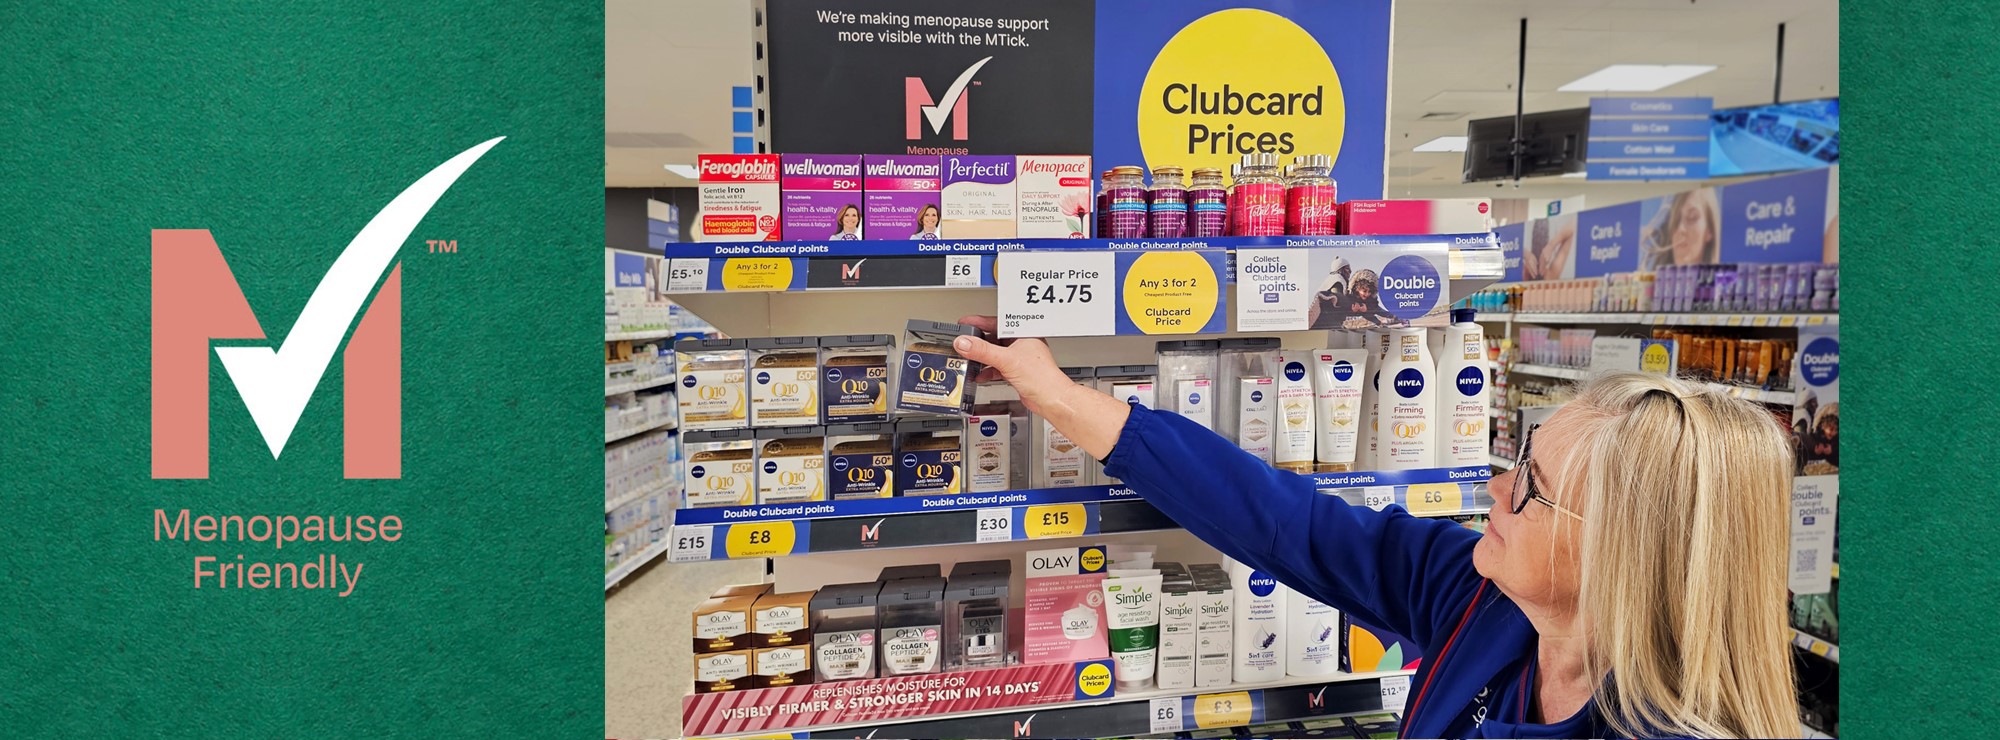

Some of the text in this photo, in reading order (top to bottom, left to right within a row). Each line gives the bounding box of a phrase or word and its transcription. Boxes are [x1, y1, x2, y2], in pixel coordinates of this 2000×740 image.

[816, 10, 1050, 32] We're making menopause support
[838, 28, 1030, 47] more visible with the MTick.
[1162, 83, 1323, 116] Clubcard
[1631, 102, 1673, 111] Cosmetics
[1651, 124, 1669, 132] Care
[1188, 123, 1295, 154] Prices
[907, 145, 969, 156] Menopause
[701, 159, 776, 178] Feroglobin
[784, 159, 859, 176] wellwoman
[866, 159, 939, 176] wellwoman
[948, 158, 1010, 181] Perfectil
[1021, 160, 1085, 177] Menopace
[1610, 166, 1638, 175] Female
[727, 186, 745, 194] Iron
[832, 180, 857, 189] 50+
[913, 180, 937, 189] 50+
[816, 206, 838, 214] vitality
[897, 206, 918, 214] vitality
[1746, 196, 1796, 220] Care &
[705, 220, 754, 228] Haemoglobin
[1591, 222, 1622, 240] Care &
[1745, 223, 1796, 250] Repair
[919, 242, 1025, 251] Double Clubcard points
[1109, 241, 1208, 250] Double Clubcard points
[1287, 238, 1380, 247] Double Clubcard points
[715, 244, 829, 255] Double Clubcard points
[1590, 244, 1621, 263] Repair
[1253, 255, 1280, 264] Collect
[736, 263, 751, 271] Any
[952, 265, 971, 276] £6
[1244, 262, 1287, 273] double
[1020, 270, 1099, 281] Regular Price
[1139, 278, 1196, 289] Any 3 for 2
[1259, 281, 1300, 294] points.
[1384, 276, 1435, 290] Double
[1026, 284, 1093, 304] £4.75
[1394, 292, 1424, 300] Clubcard
[1399, 300, 1420, 308] points
[1005, 313, 1045, 322] Menopace
[1145, 307, 1191, 317] Clubcard
[1155, 317, 1181, 326] Price
[1804, 353, 1839, 366] Double
[1394, 406, 1424, 414] Firming
[1456, 404, 1483, 413] Firming
[848, 467, 875, 482] Q10
[916, 463, 943, 479] Q10
[1449, 471, 1478, 479] Double
[707, 475, 734, 490] Q10
[779, 471, 805, 486] Q10
[1314, 476, 1375, 485] Clubcard points
[922, 493, 1027, 507] Double Clubcard points
[1424, 491, 1442, 503] £6
[723, 505, 835, 519] Double Clubcard points
[980, 518, 1008, 530] £30
[1043, 512, 1069, 526] £15
[678, 537, 705, 549] £15
[749, 530, 771, 545] £8
[1033, 556, 1073, 570] OLAY
[1116, 592, 1152, 605] Simple
[1165, 606, 1193, 616] Simple
[1201, 604, 1229, 614] Simple
[710, 615, 732, 623] OLAY
[969, 618, 996, 628] OLAY
[829, 632, 860, 644] OLAY
[896, 628, 926, 639] OLAY
[824, 647, 863, 656] COLLAGEN
[890, 642, 929, 651] COLLAGEN
[890, 648, 920, 656] PEPTIDE
[1081, 673, 1110, 681] Clubcard
[813, 676, 965, 699] REPLENISHES MOISTURE FOR
[721, 706, 774, 720] VISIBLY
[779, 701, 829, 715] FIRMER
[834, 700, 846, 711] &
[849, 692, 928, 709] STRONGER
[929, 687, 961, 703] SKIN
[965, 687, 981, 698] IN
[985, 685, 1001, 696] 14
[1214, 701, 1232, 713] £3
[1157, 707, 1174, 719] £6
